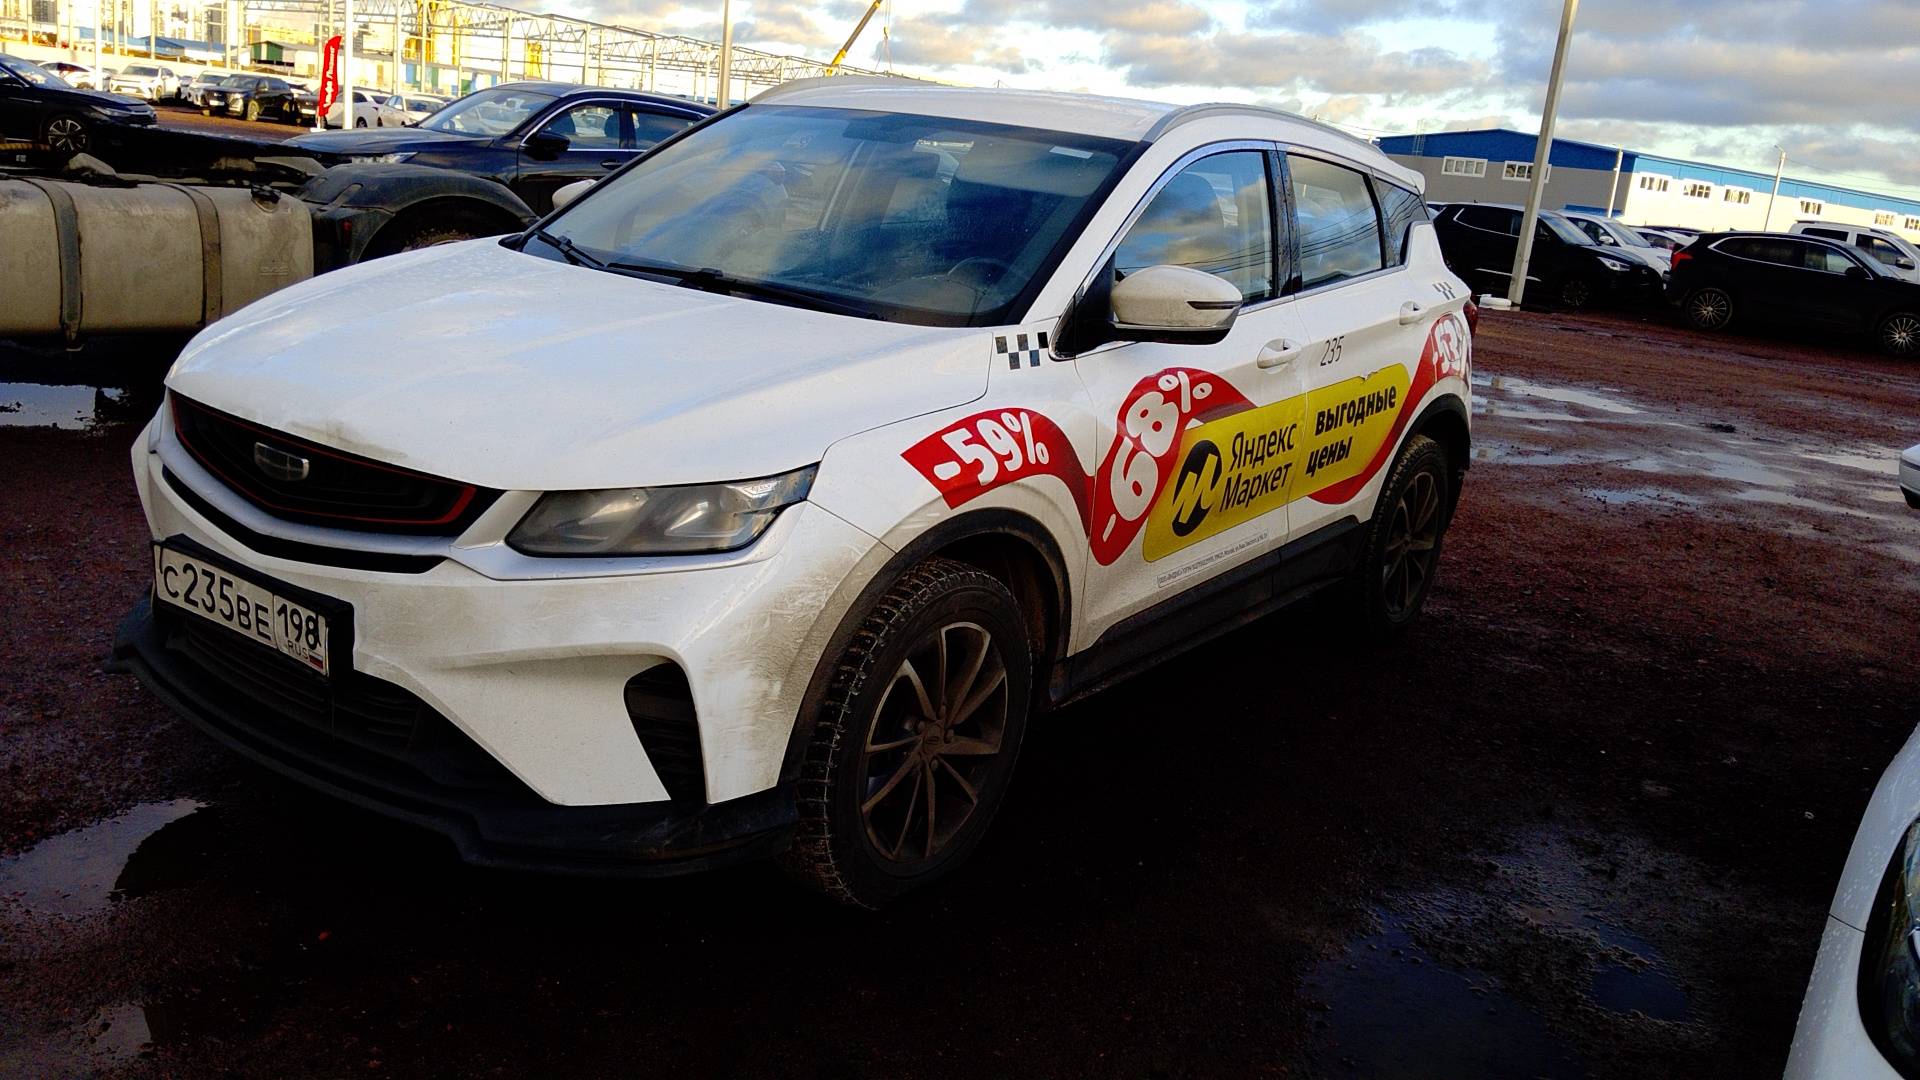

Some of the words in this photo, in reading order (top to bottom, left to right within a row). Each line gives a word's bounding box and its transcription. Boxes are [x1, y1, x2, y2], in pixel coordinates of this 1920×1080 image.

[1320, 335, 1344, 366] 235
[1315, 386, 1397, 436] выгодные
[933, 411, 1049, 486] -59%
[1102, 371, 1212, 542] -68%
[1229, 423, 1298, 473] Яндекс
[1305, 436, 1353, 478] цены
[1219, 462, 1293, 513] Маркет
[277, 603, 318, 650] 198
[287, 640, 309, 660] RUS
